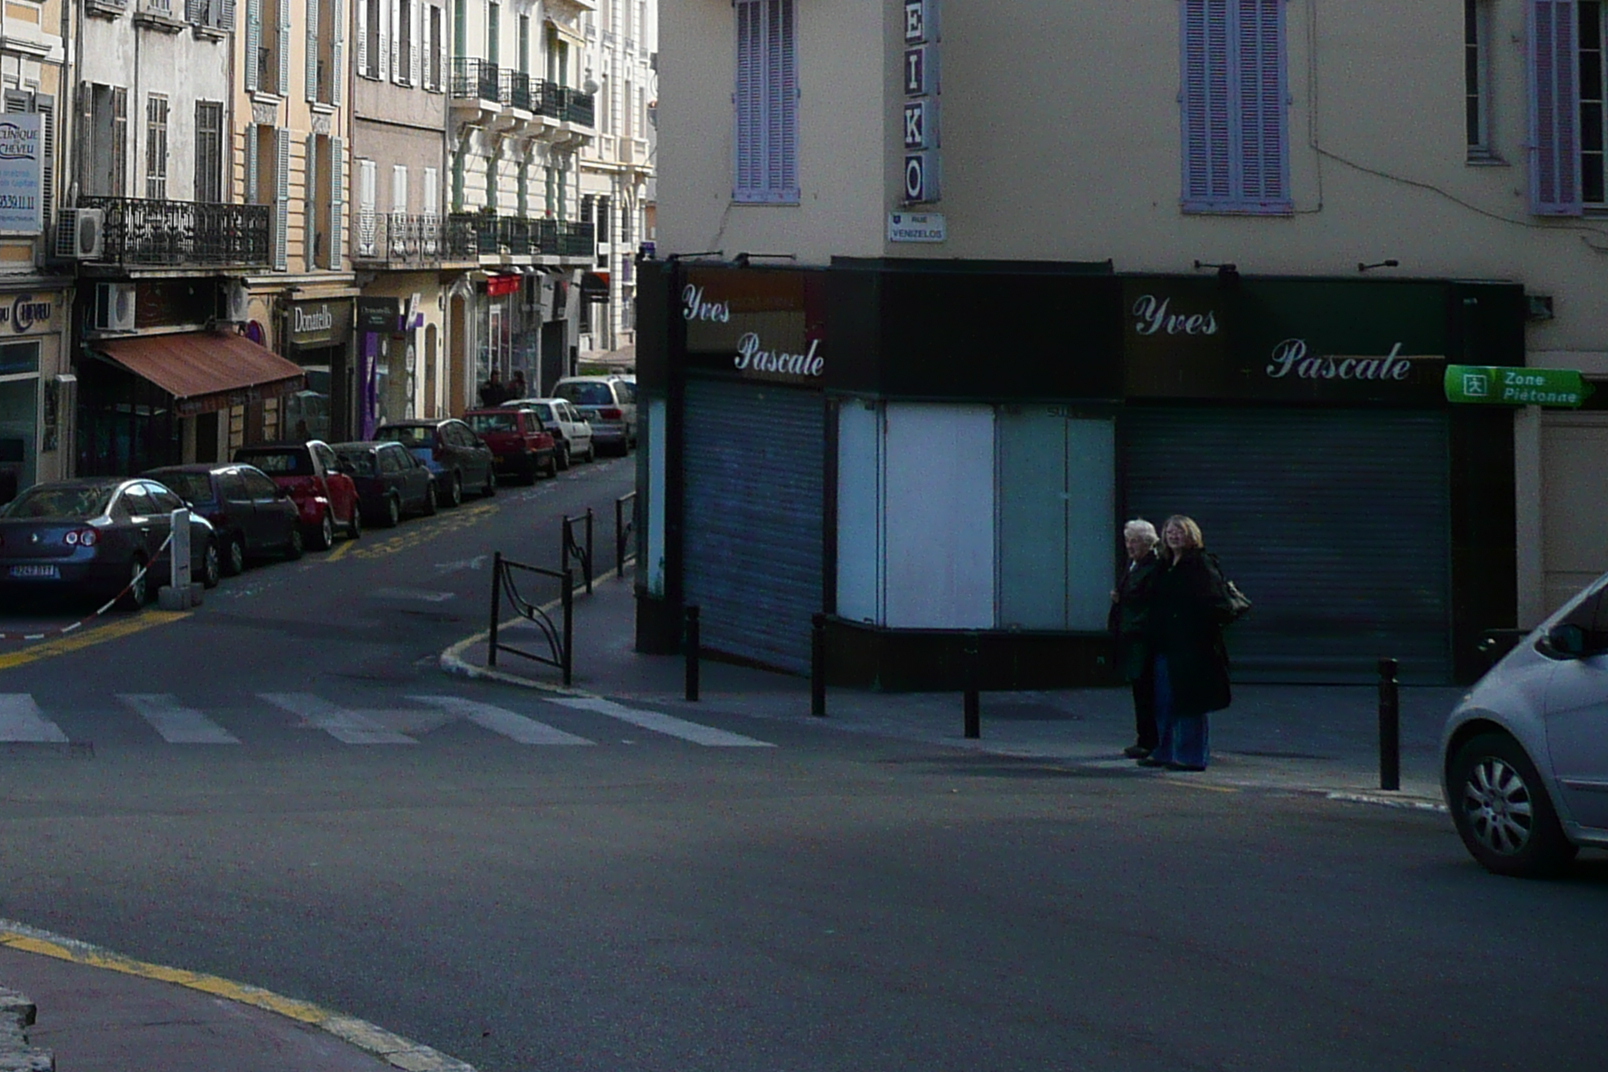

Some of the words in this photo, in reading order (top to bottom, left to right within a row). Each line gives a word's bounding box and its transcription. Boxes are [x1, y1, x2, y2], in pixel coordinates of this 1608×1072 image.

[892, 228, 943, 239] VENIZELOS
[911, 216, 928, 224] RUE
[11, 293, 52, 333] CHEVEU
[294, 303, 332, 333] Donatello
[682, 283, 730, 323] Yves
[1132, 294, 1218, 336] Yves
[734, 332, 825, 377] Pascale
[1266, 337, 1411, 381] Pascale
[1504, 371, 1546, 386] Zone
